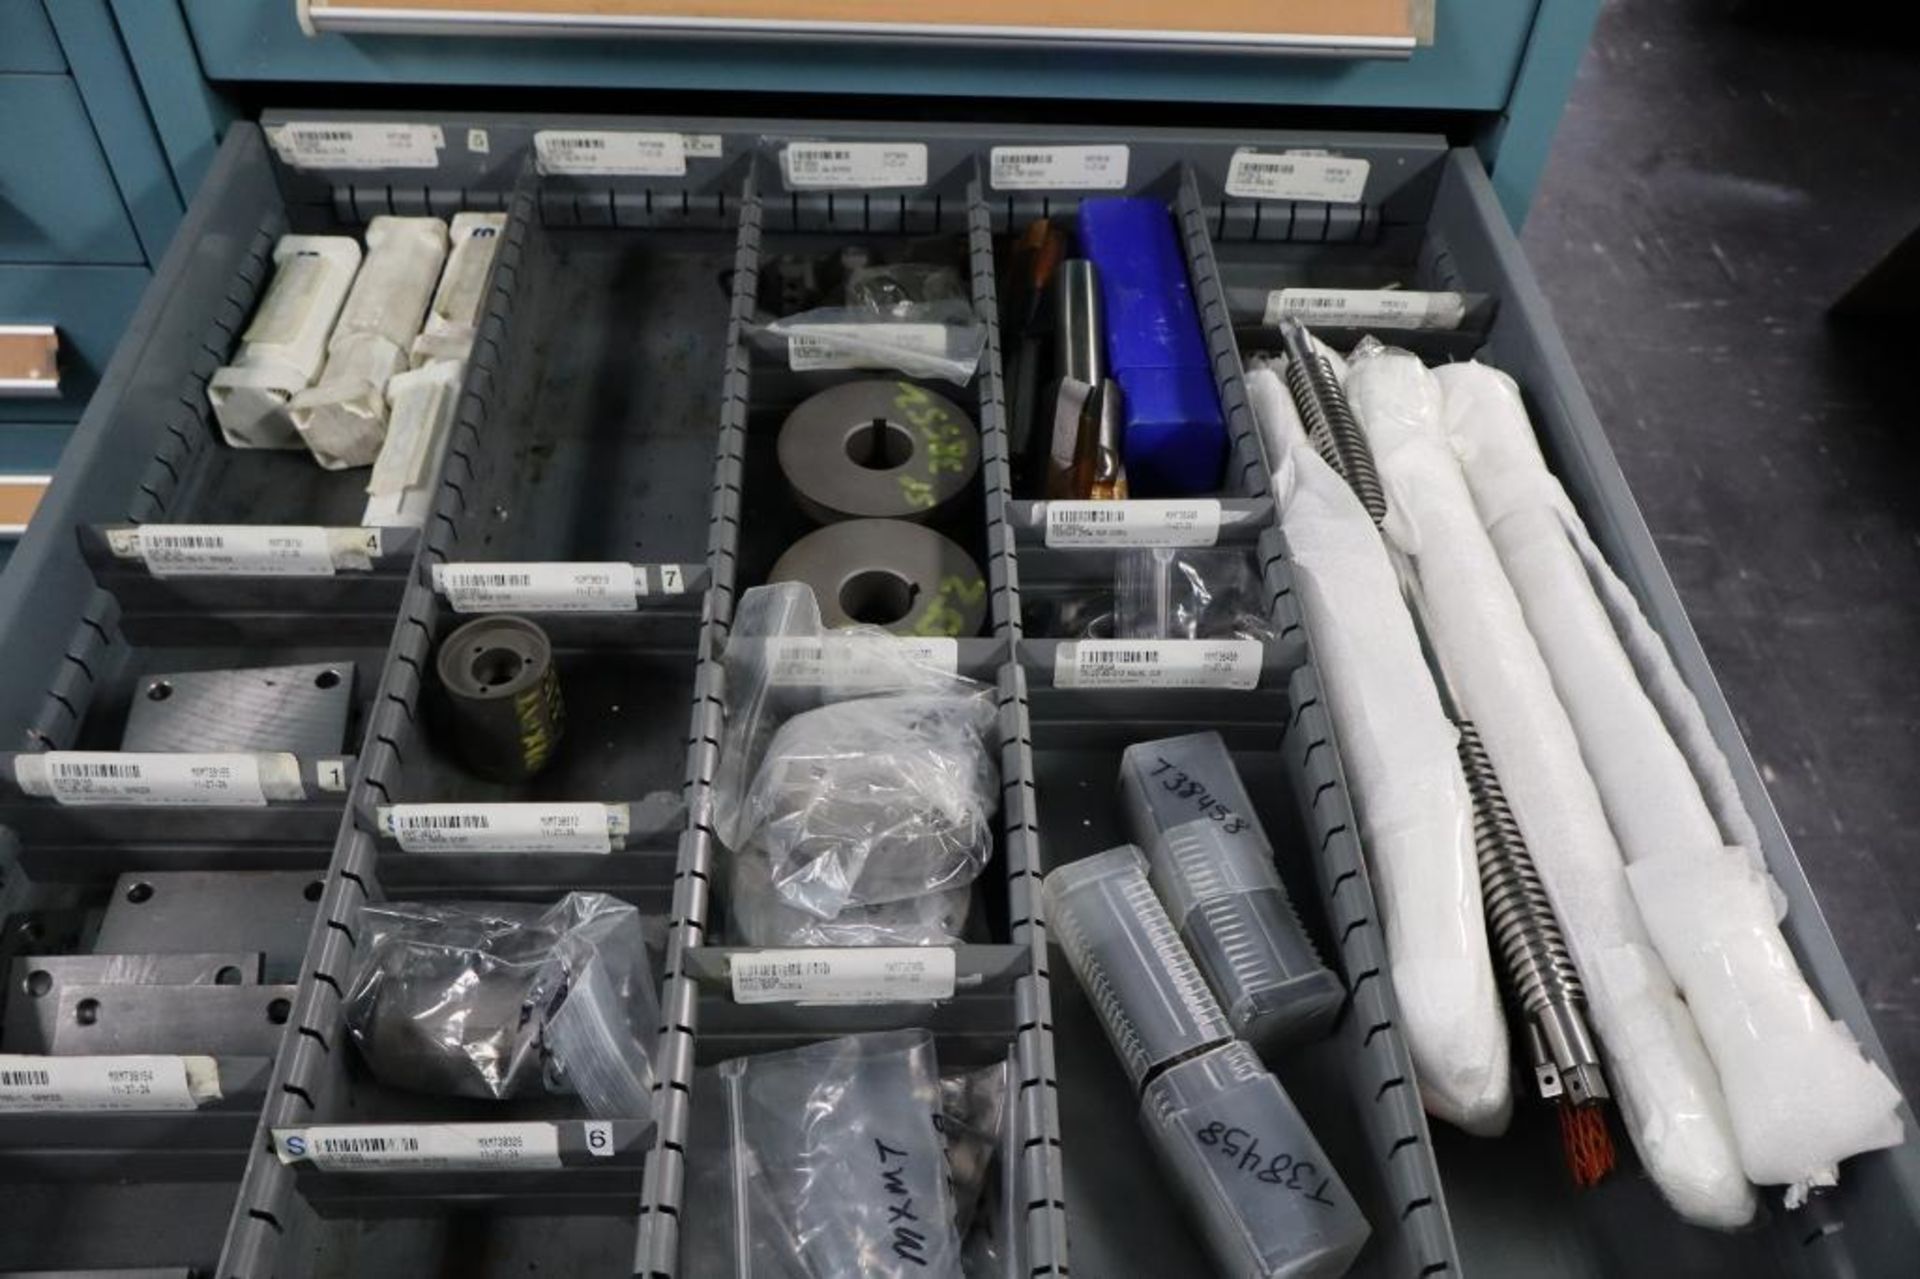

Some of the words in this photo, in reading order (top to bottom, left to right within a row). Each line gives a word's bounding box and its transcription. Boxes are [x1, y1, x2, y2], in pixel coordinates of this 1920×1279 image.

[366, 534, 378, 551] 4
[664, 570, 677, 588] 7
[329, 767, 340, 787] 1
[1150, 757, 1250, 835] T38458
[286, 1136, 306, 1157] S
[589, 1129, 606, 1149] 6
[1197, 1120, 1335, 1207] T38458
